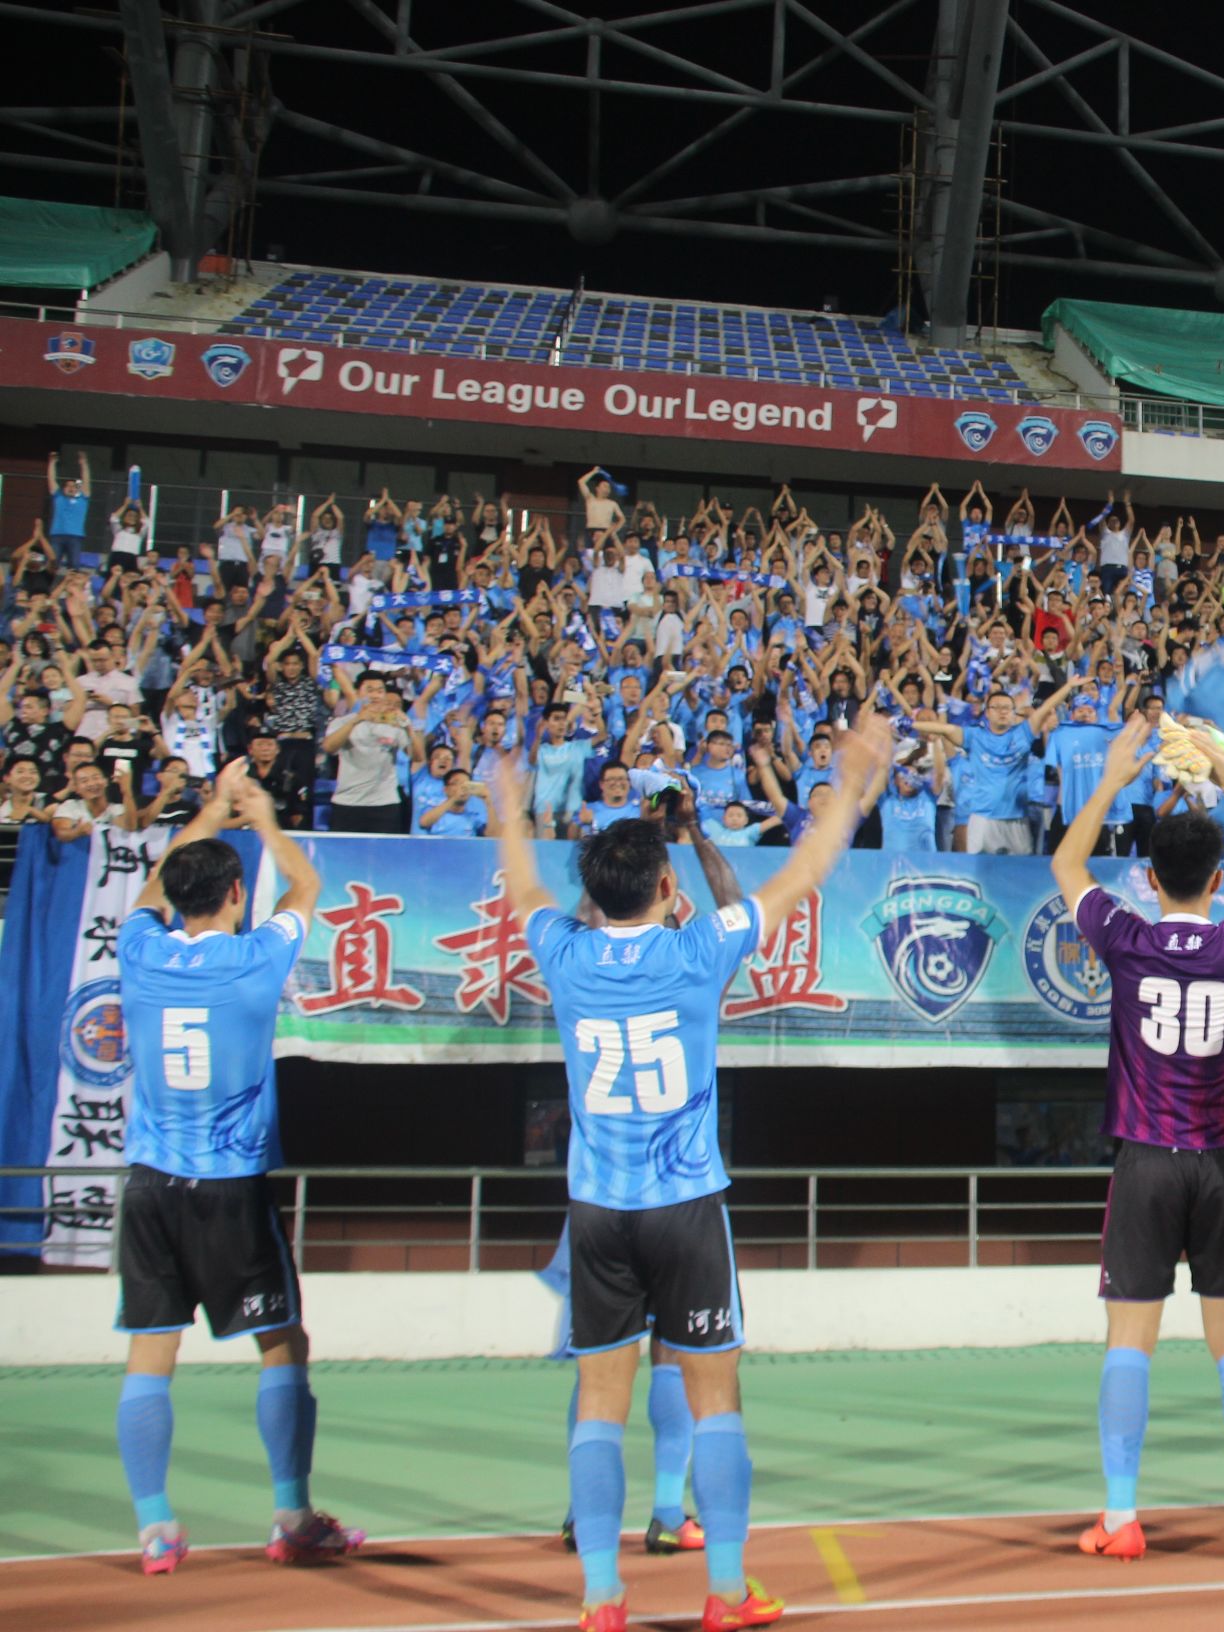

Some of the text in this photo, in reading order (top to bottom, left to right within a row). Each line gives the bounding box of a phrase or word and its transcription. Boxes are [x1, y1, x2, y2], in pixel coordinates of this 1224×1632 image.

[339, 360, 834, 432] Our League Our Legend
[883, 894, 989, 919] RONGDA
[162, 1007, 211, 1091] 5
[575, 1010, 688, 1115] 25
